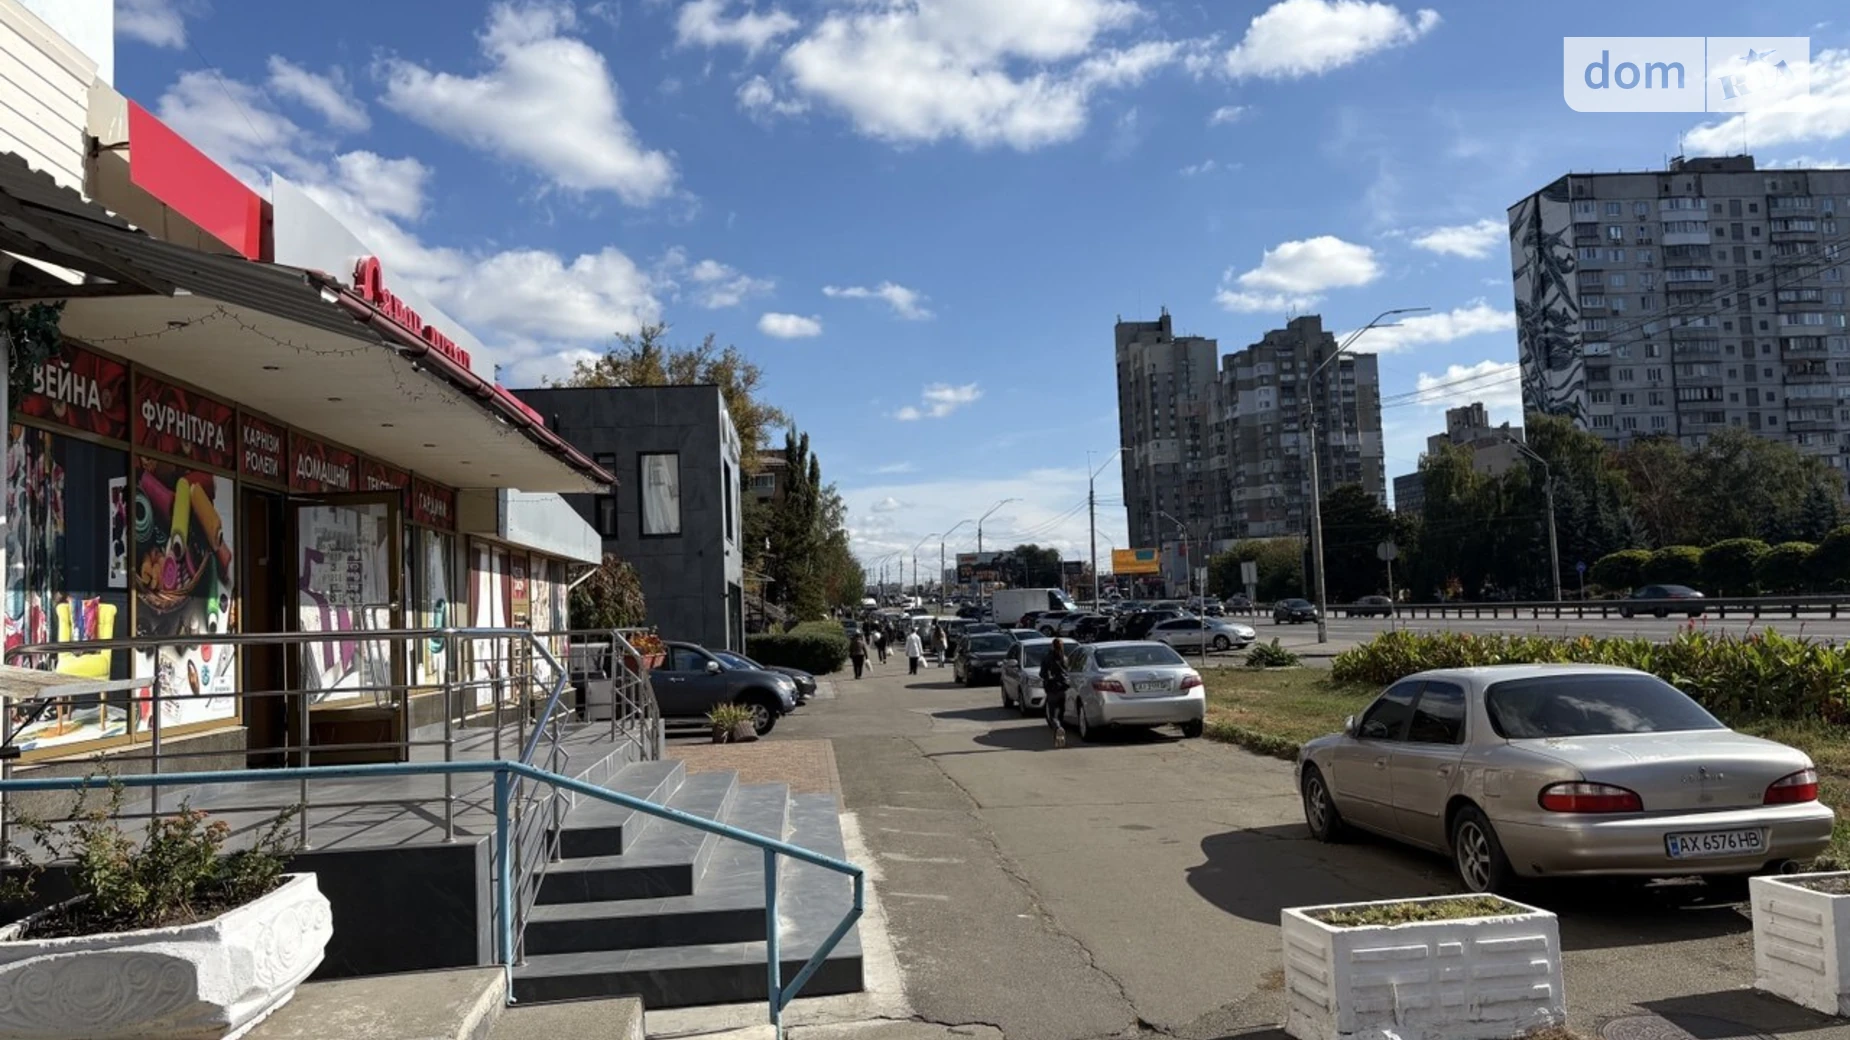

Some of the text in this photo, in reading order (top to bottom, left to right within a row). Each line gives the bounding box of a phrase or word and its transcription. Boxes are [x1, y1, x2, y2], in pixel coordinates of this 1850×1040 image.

[141, 398, 226, 452] ФУРНІТУРА
[243, 425, 280, 454] КАРНІЗИ
[245, 450, 279, 478] РОЛЕТИ
[296, 453, 350, 489] ДОМАШНІЙ
[1680, 831, 1760, 853] AX 6576 HB
